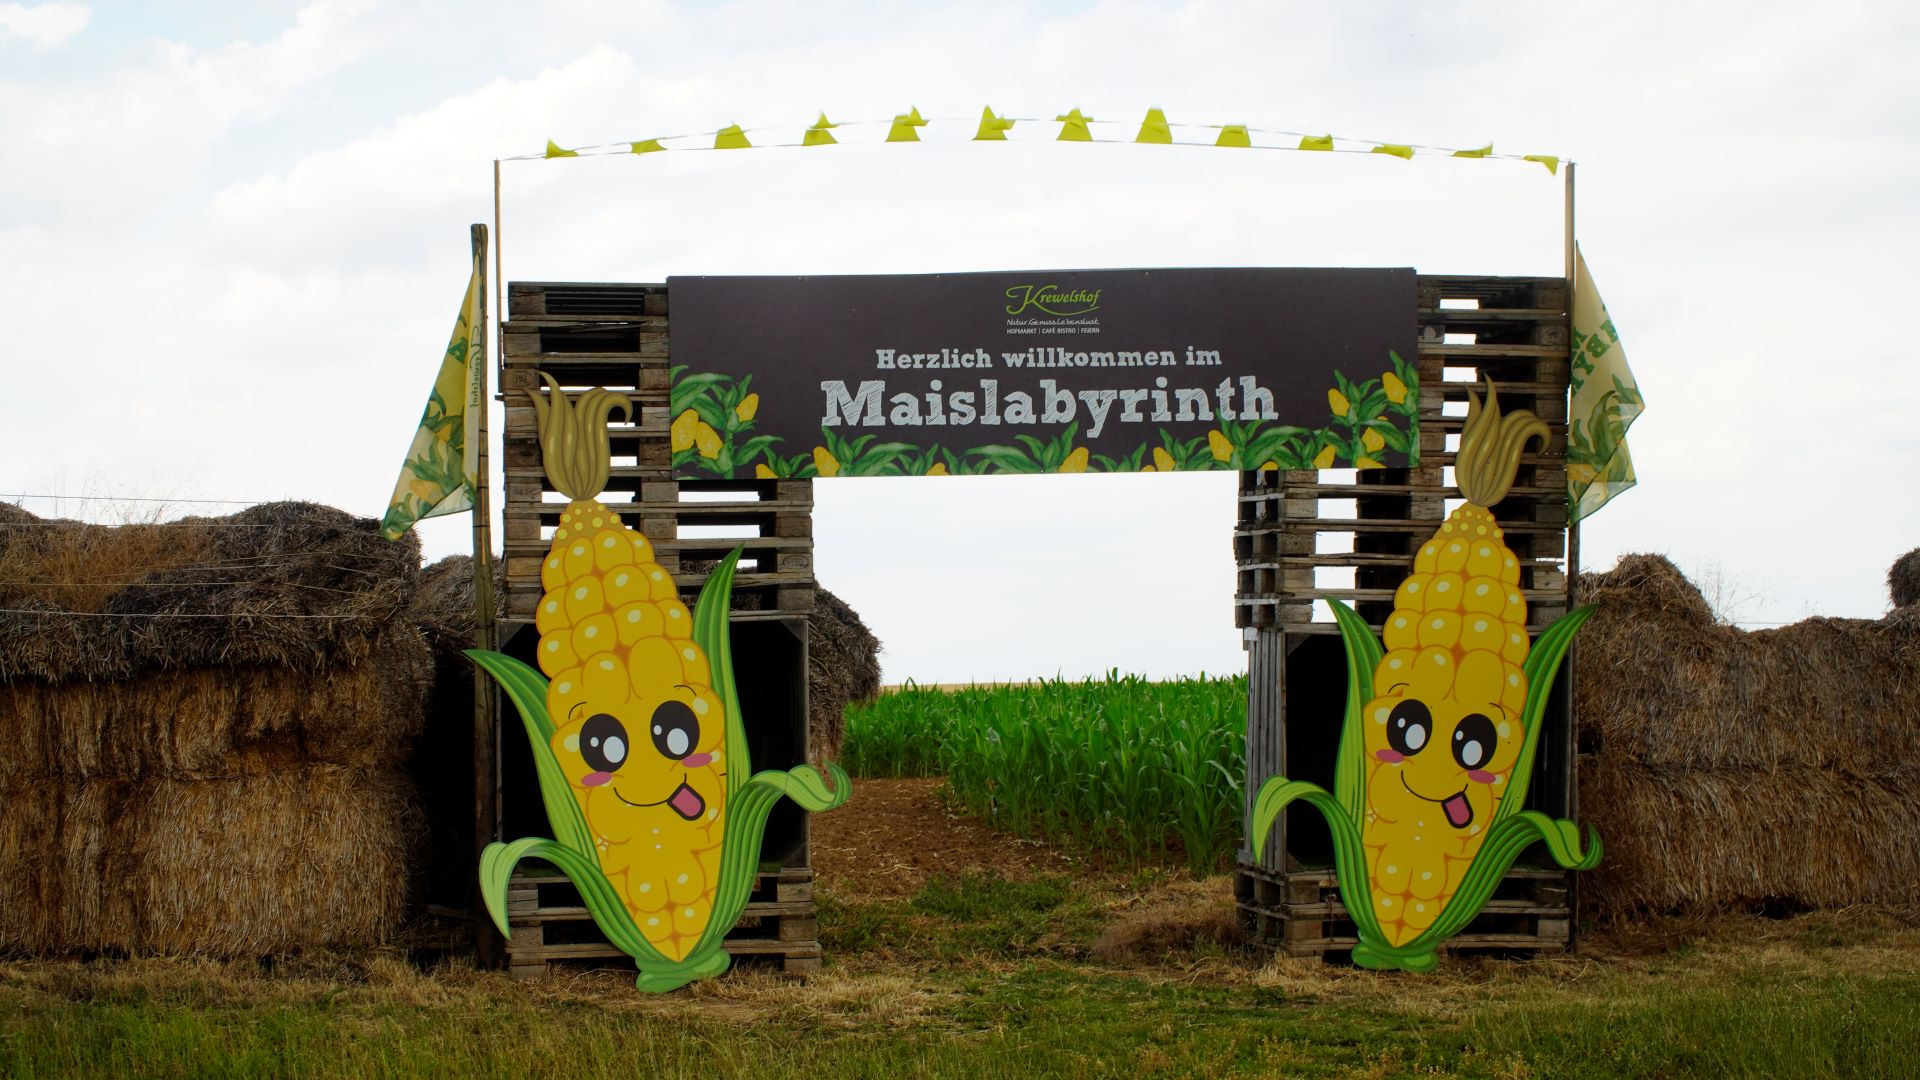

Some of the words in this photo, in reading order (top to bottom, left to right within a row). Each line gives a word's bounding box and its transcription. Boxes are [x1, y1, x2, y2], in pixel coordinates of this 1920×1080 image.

[1005, 284, 1102, 316] Krewelshof
[1006, 327, 1037, 335] HOFMARKT
[1057, 326, 1076, 334] BISTRO
[1080, 326, 1100, 334] FEIERN
[876, 348, 992, 369] Herzlich
[1001, 347, 1176, 368] willkommen
[1185, 345, 1222, 366] im
[820, 376, 1279, 438] Maislabyrinth
